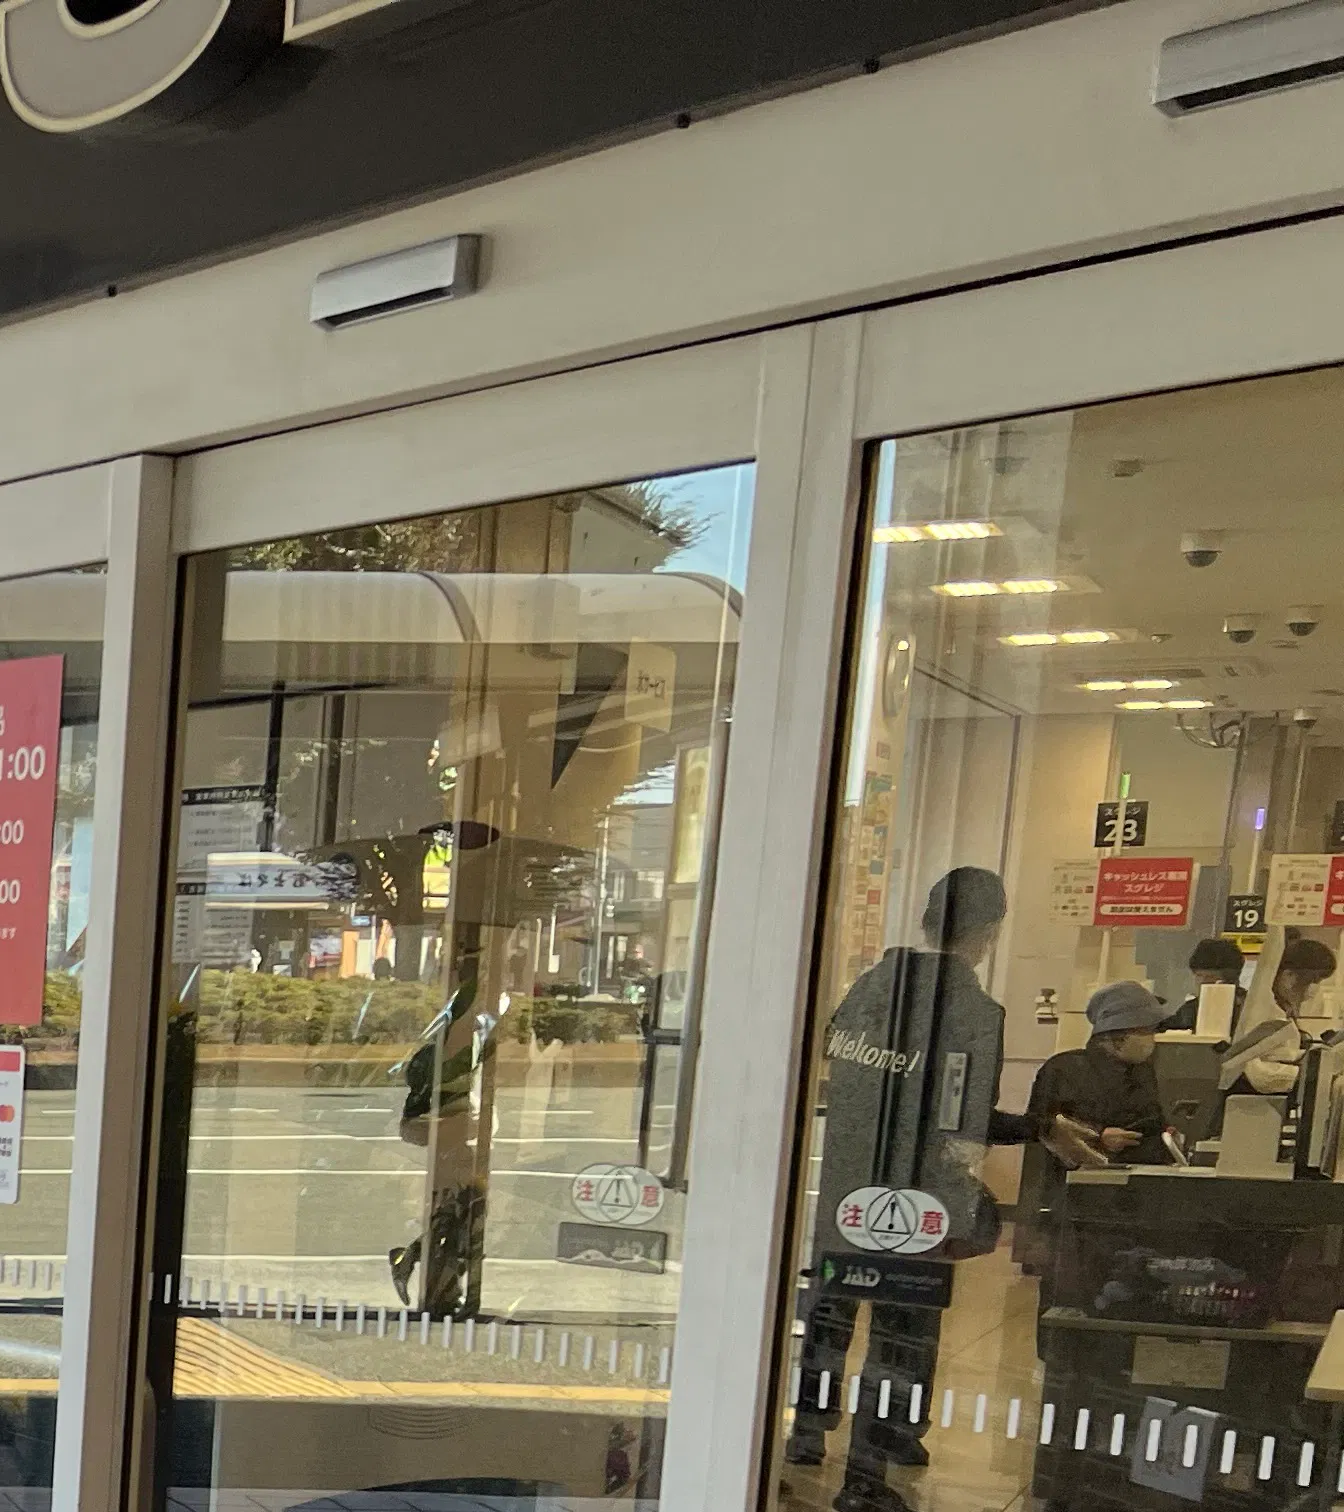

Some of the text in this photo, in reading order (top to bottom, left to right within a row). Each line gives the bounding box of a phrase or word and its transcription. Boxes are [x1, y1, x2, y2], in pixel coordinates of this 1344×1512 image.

[1103, 819, 1138, 842] 23
[1234, 909, 1259, 928] 19
[828, 1028, 920, 1078] Welcome!
[840, 1203, 943, 1235] 注 意
